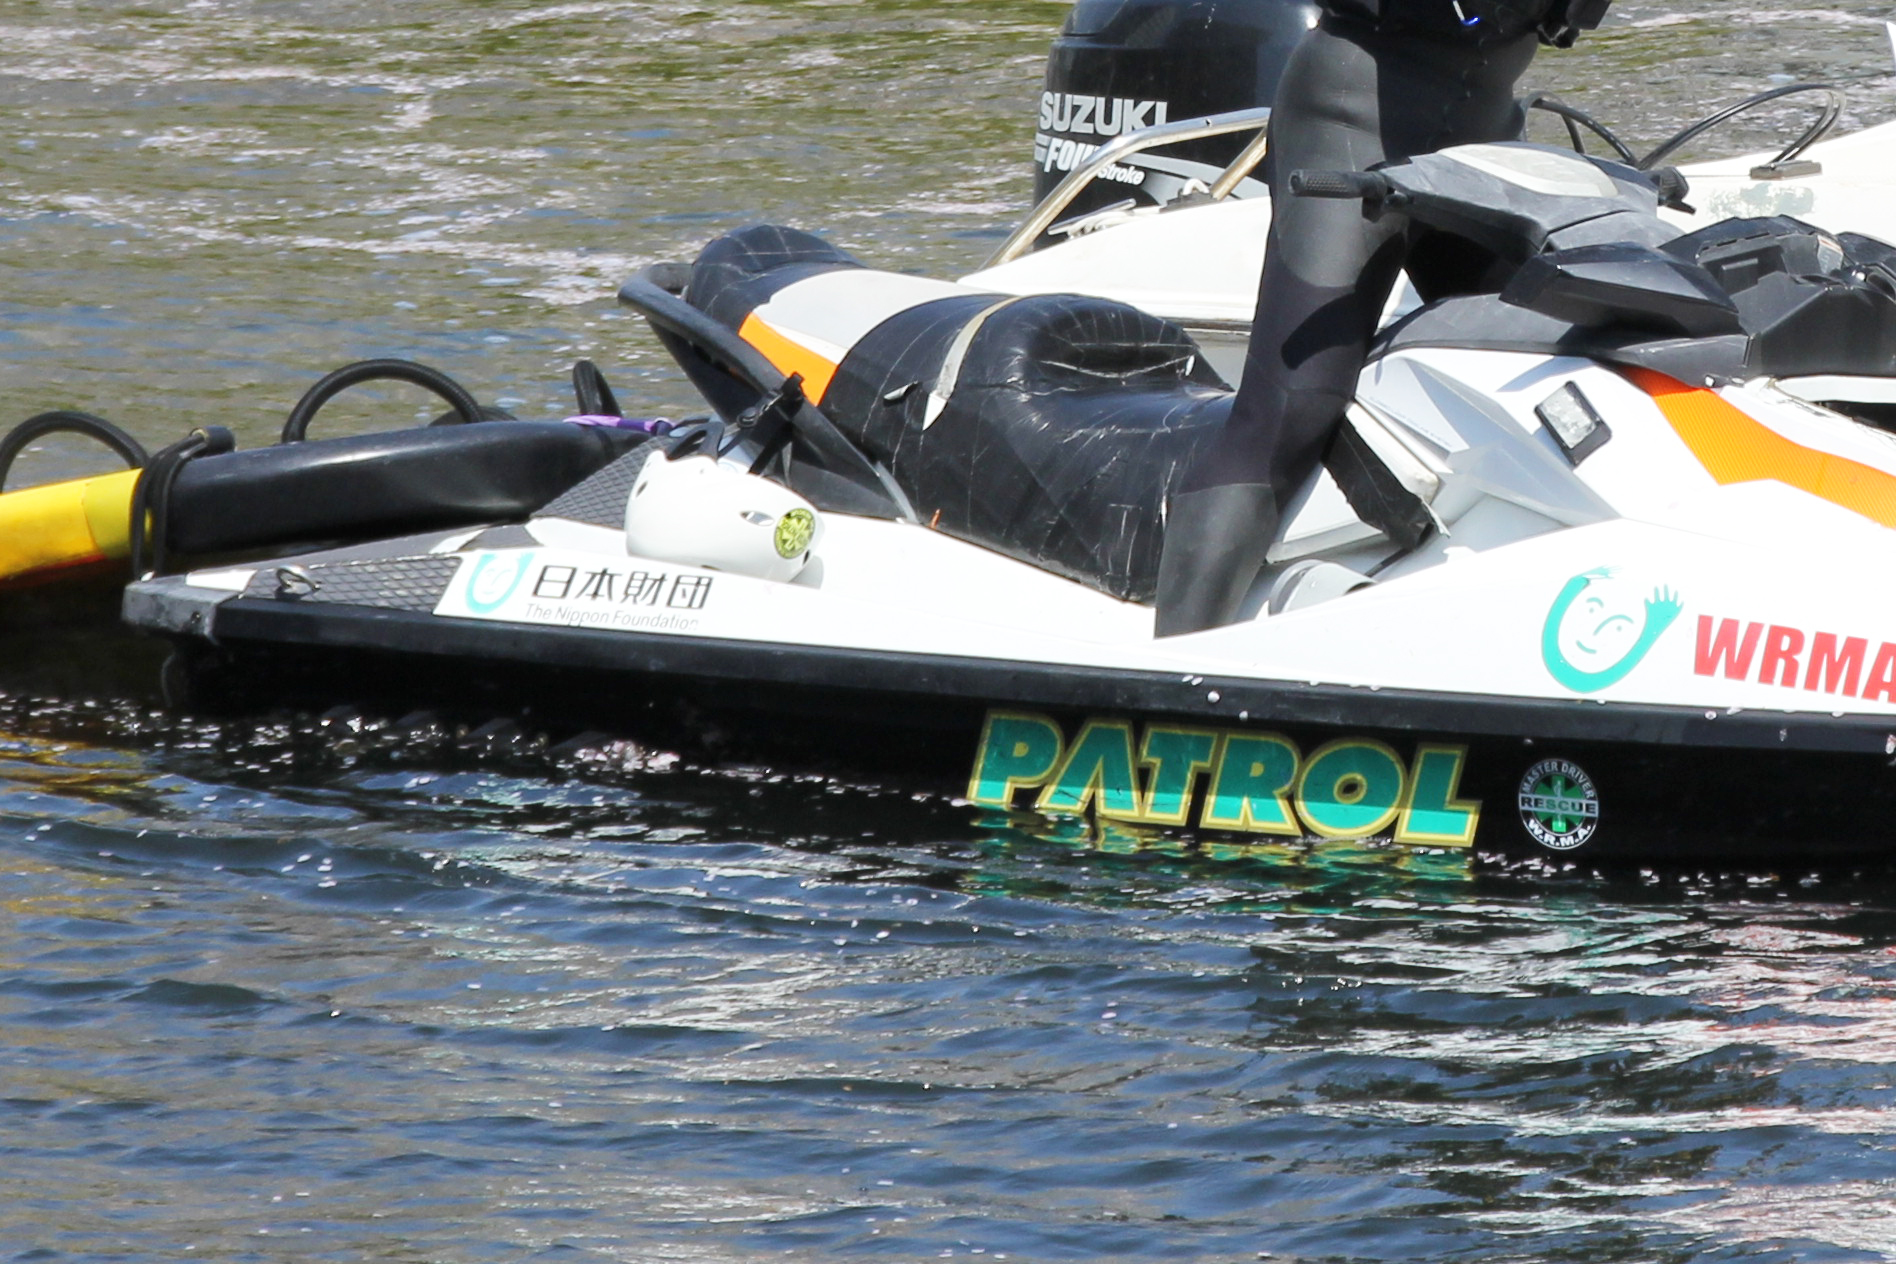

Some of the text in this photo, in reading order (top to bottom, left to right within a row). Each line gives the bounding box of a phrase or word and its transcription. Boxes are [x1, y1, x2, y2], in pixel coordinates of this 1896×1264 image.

[1040, 91, 1168, 136] SUZUKI
[531, 565, 714, 610] 日本財団
[525, 603, 699, 631] The Nippon Foundation
[966, 709, 1483, 848] PATROL
[1521, 761, 1595, 799] MASTER DRIVER
[1520, 796, 1597, 814] RESCUE
[1528, 818, 1591, 847] W.R.M.A.
